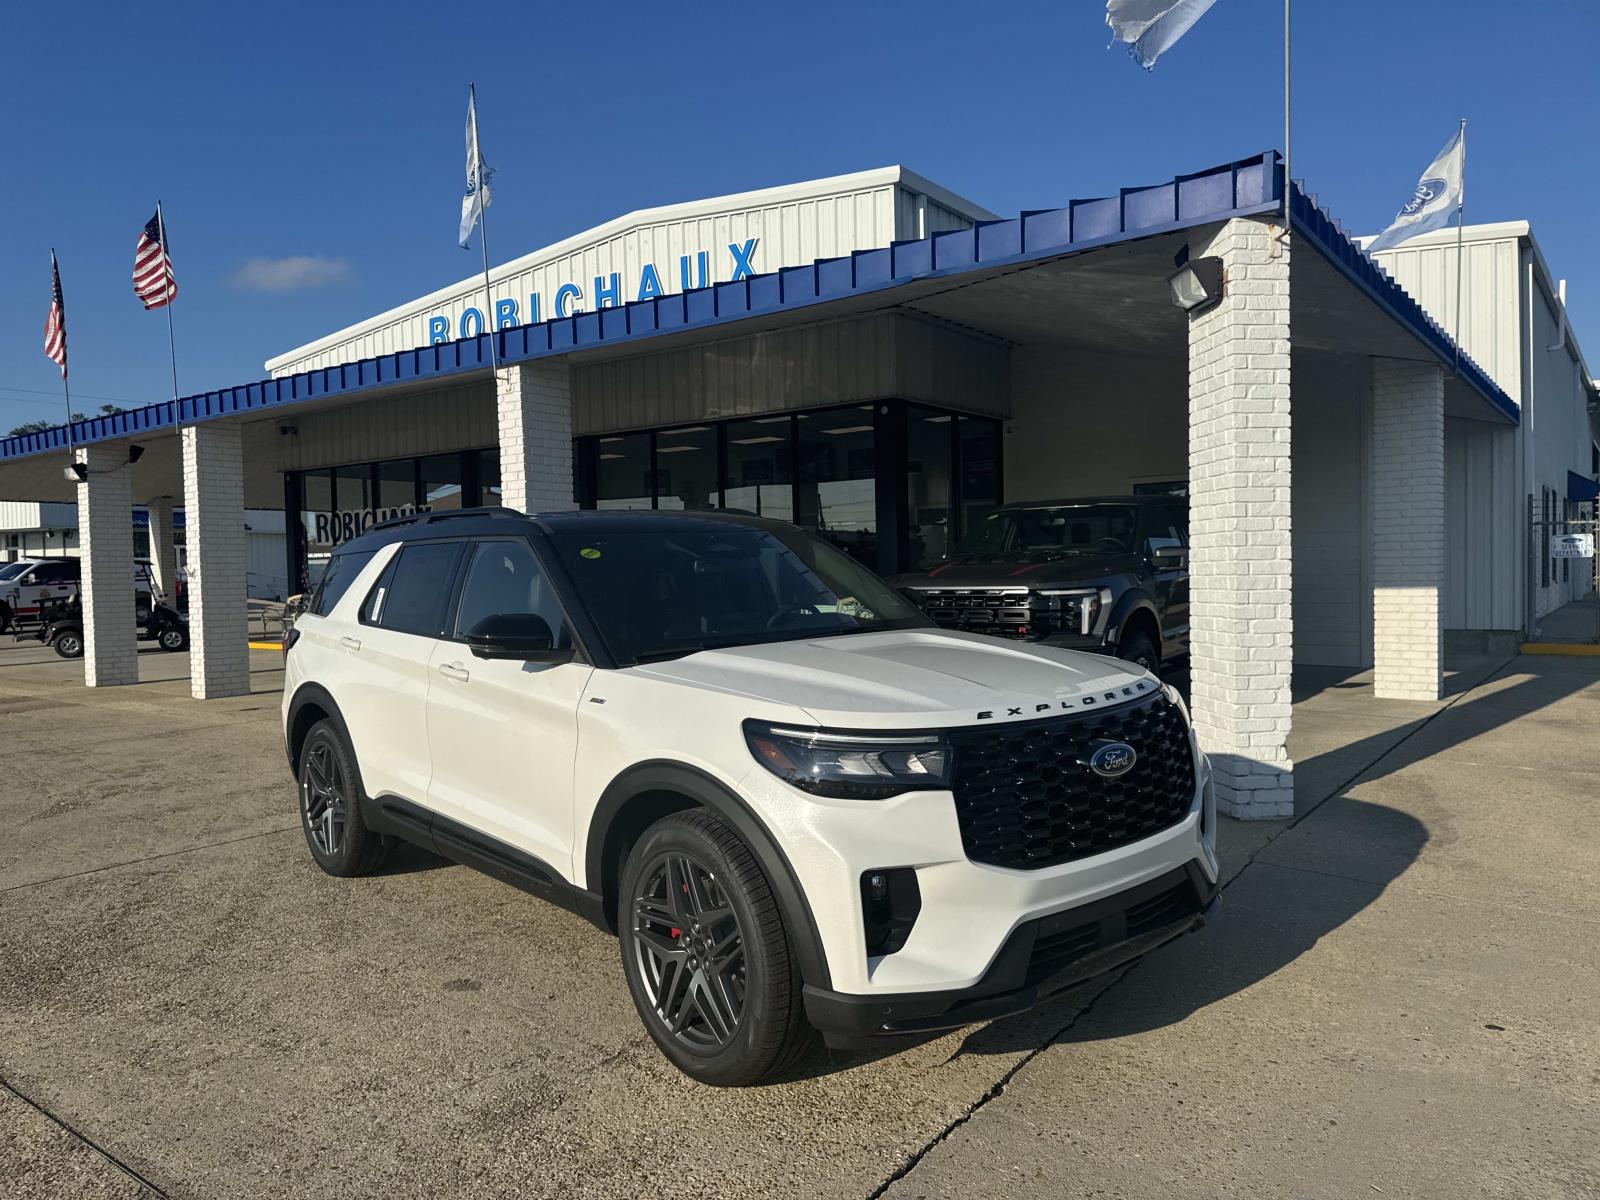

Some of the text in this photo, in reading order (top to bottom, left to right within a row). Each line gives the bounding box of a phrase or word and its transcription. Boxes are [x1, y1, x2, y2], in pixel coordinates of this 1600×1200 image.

[428, 237, 759, 346] ROBICHAUX
[315, 503, 433, 546] ROBIC
[976, 682, 1146, 720] EXPLORER
[1104, 750, 1129, 770] Ford
